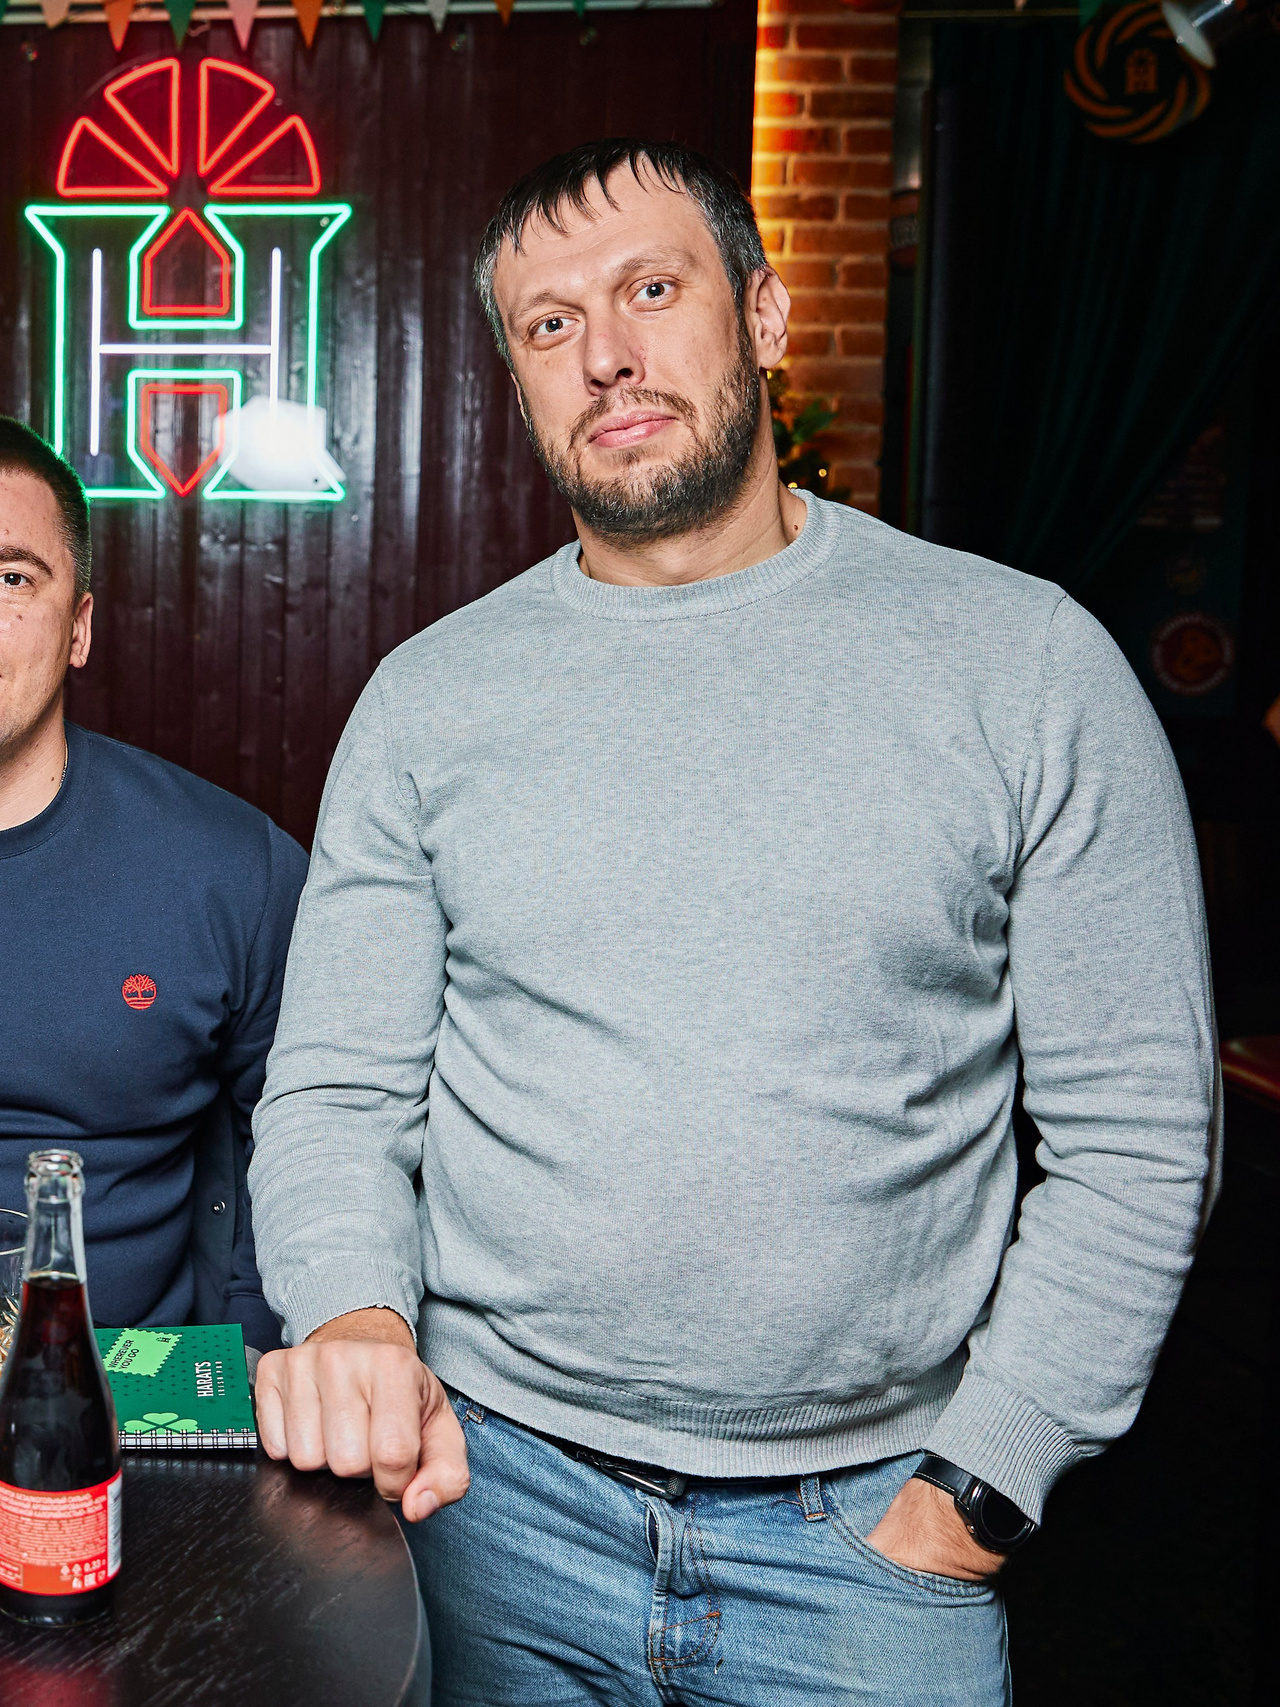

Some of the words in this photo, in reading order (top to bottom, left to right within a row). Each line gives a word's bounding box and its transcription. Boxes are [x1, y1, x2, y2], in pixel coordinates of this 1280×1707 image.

[108, 1339, 134, 1368] WHEREVER
[119, 1356, 133, 1369] YOU
[129, 1348, 140, 1359] GO
